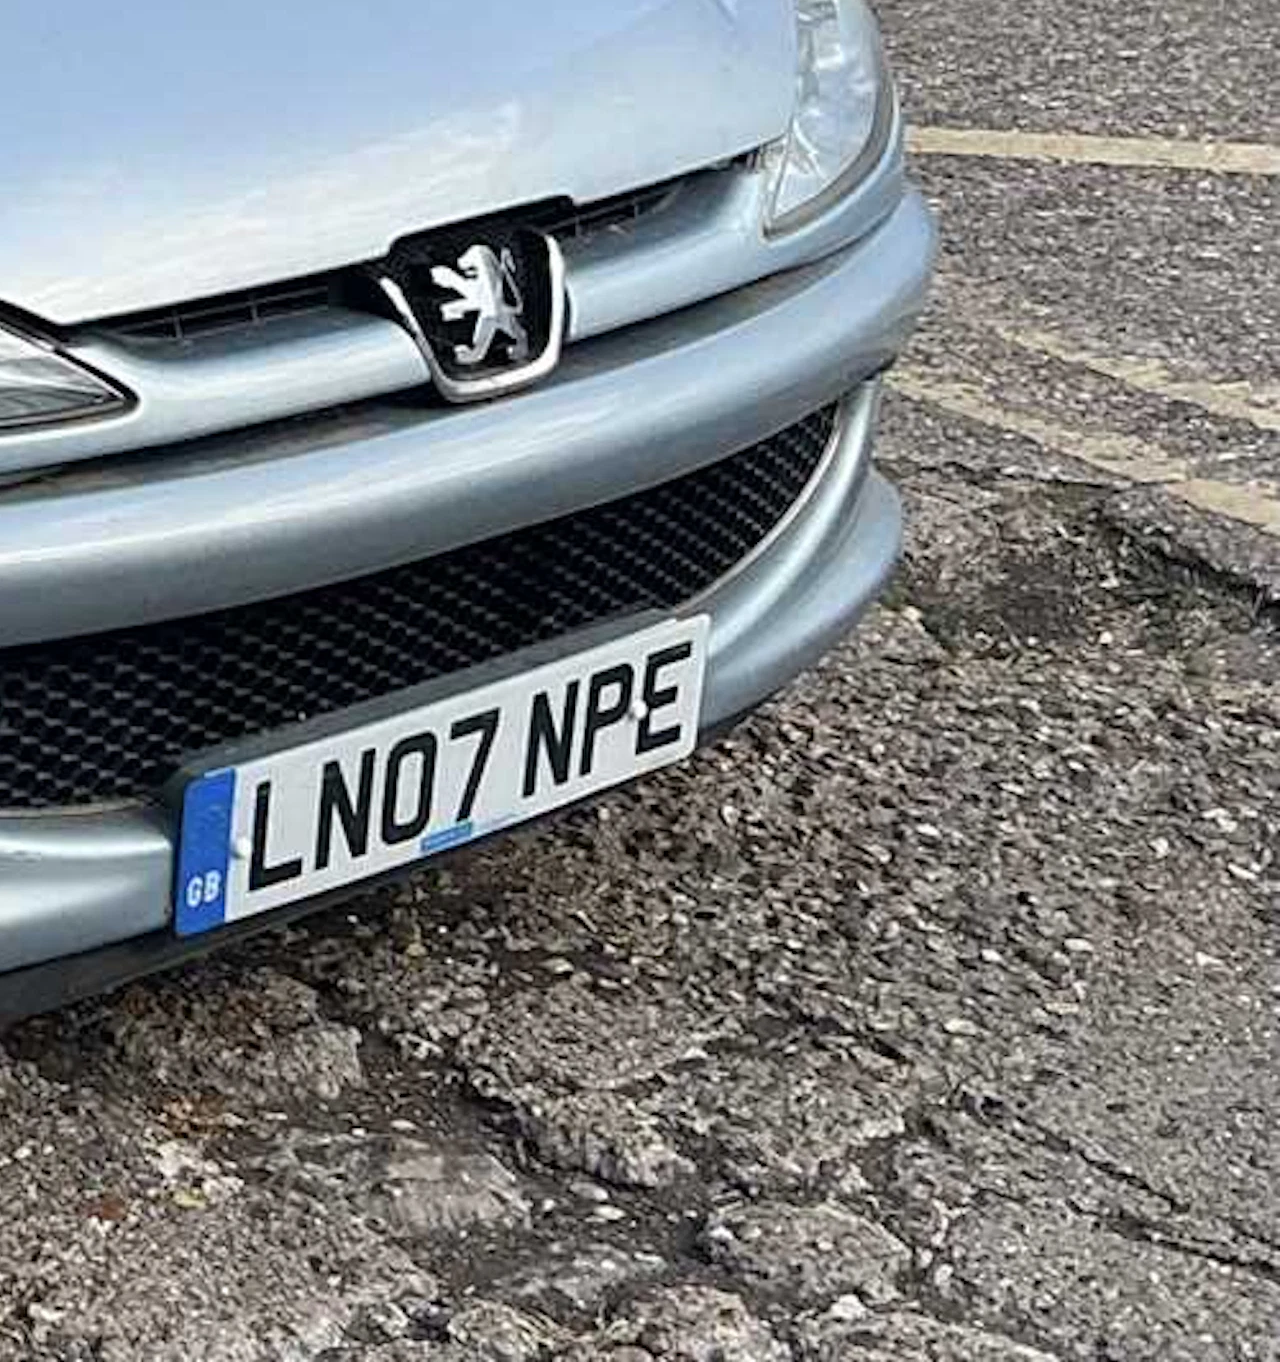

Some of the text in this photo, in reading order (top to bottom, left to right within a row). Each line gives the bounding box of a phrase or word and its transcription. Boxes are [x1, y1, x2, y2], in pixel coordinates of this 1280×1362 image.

[248, 643, 691, 891] LN07 NPE
[185, 872, 221, 906] GB
